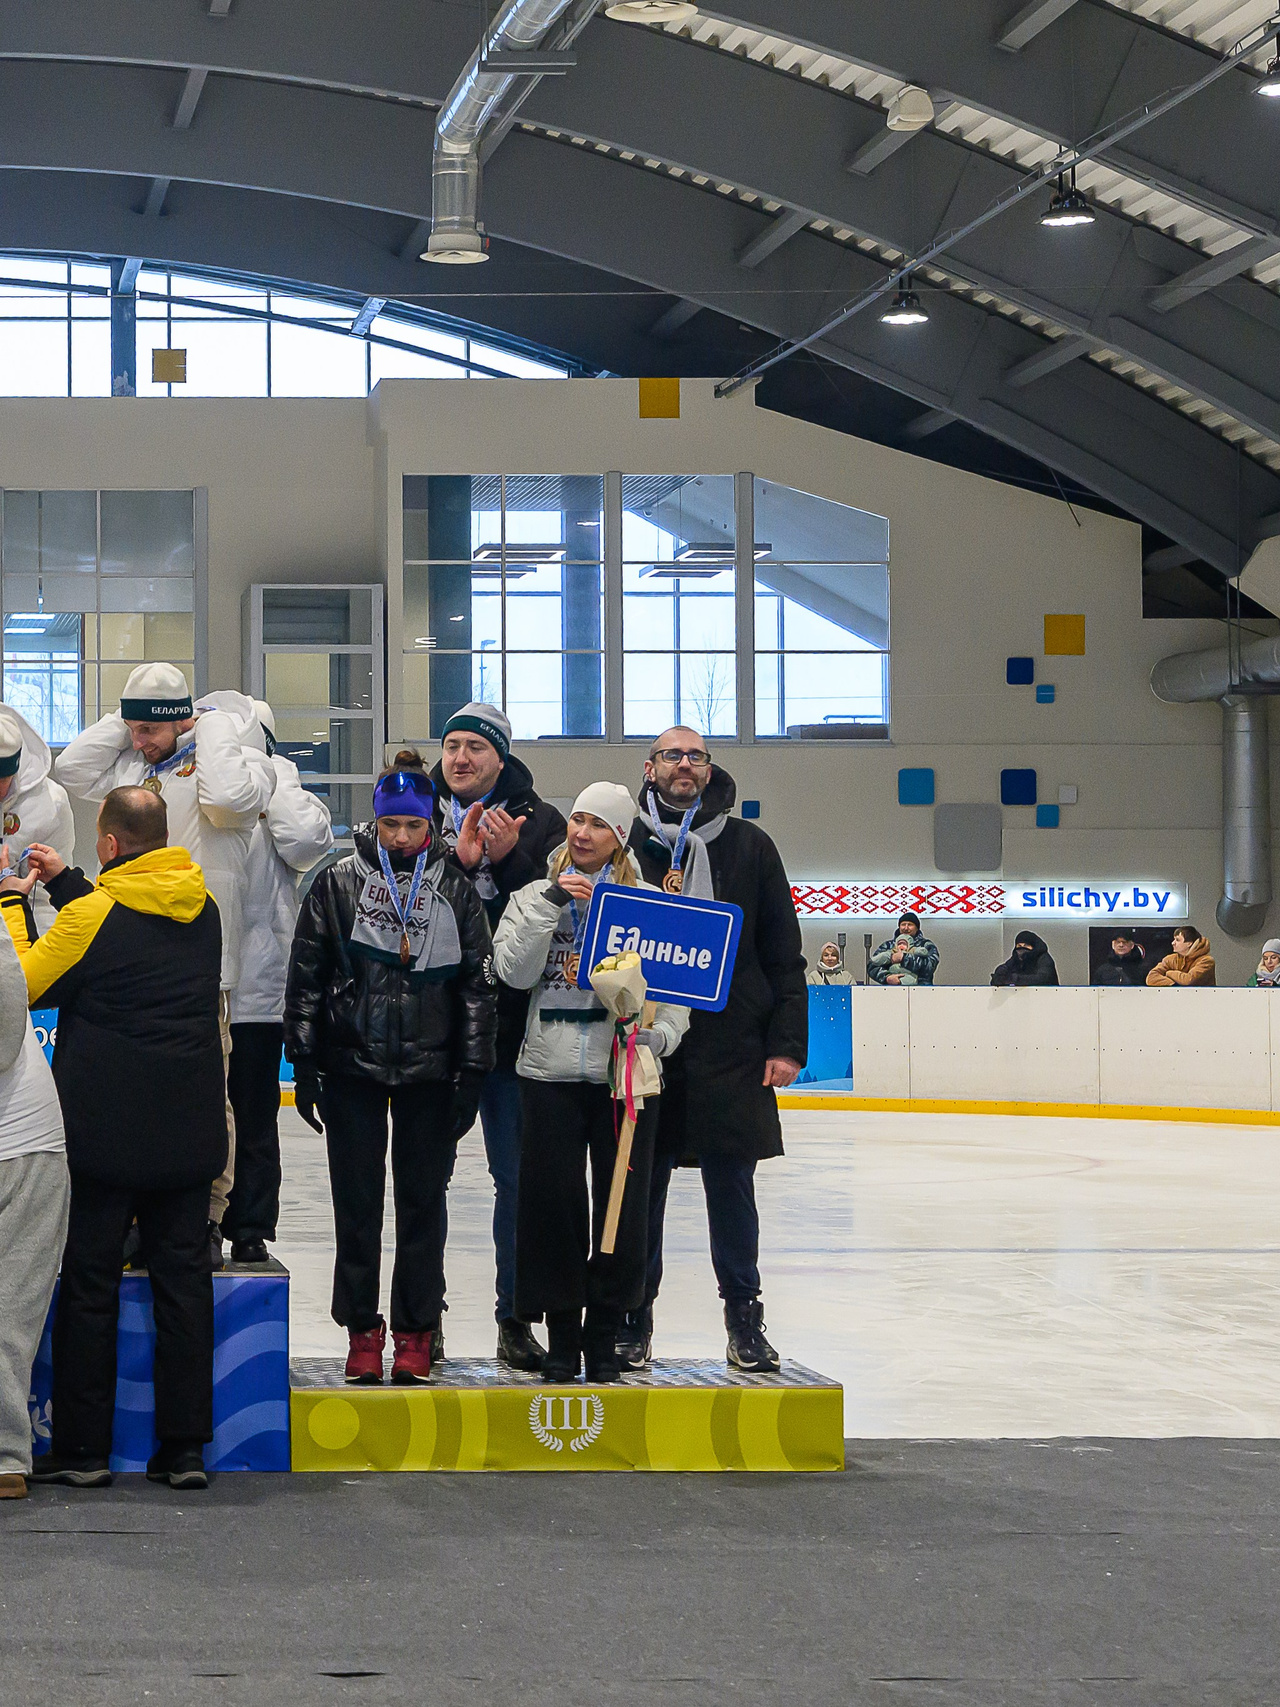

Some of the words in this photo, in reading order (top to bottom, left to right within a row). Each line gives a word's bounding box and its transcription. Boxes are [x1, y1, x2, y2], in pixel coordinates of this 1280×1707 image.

[1022, 887, 1171, 912] silichy.by
[606, 924, 712, 970] Единые
[541, 1396, 593, 1430] III
